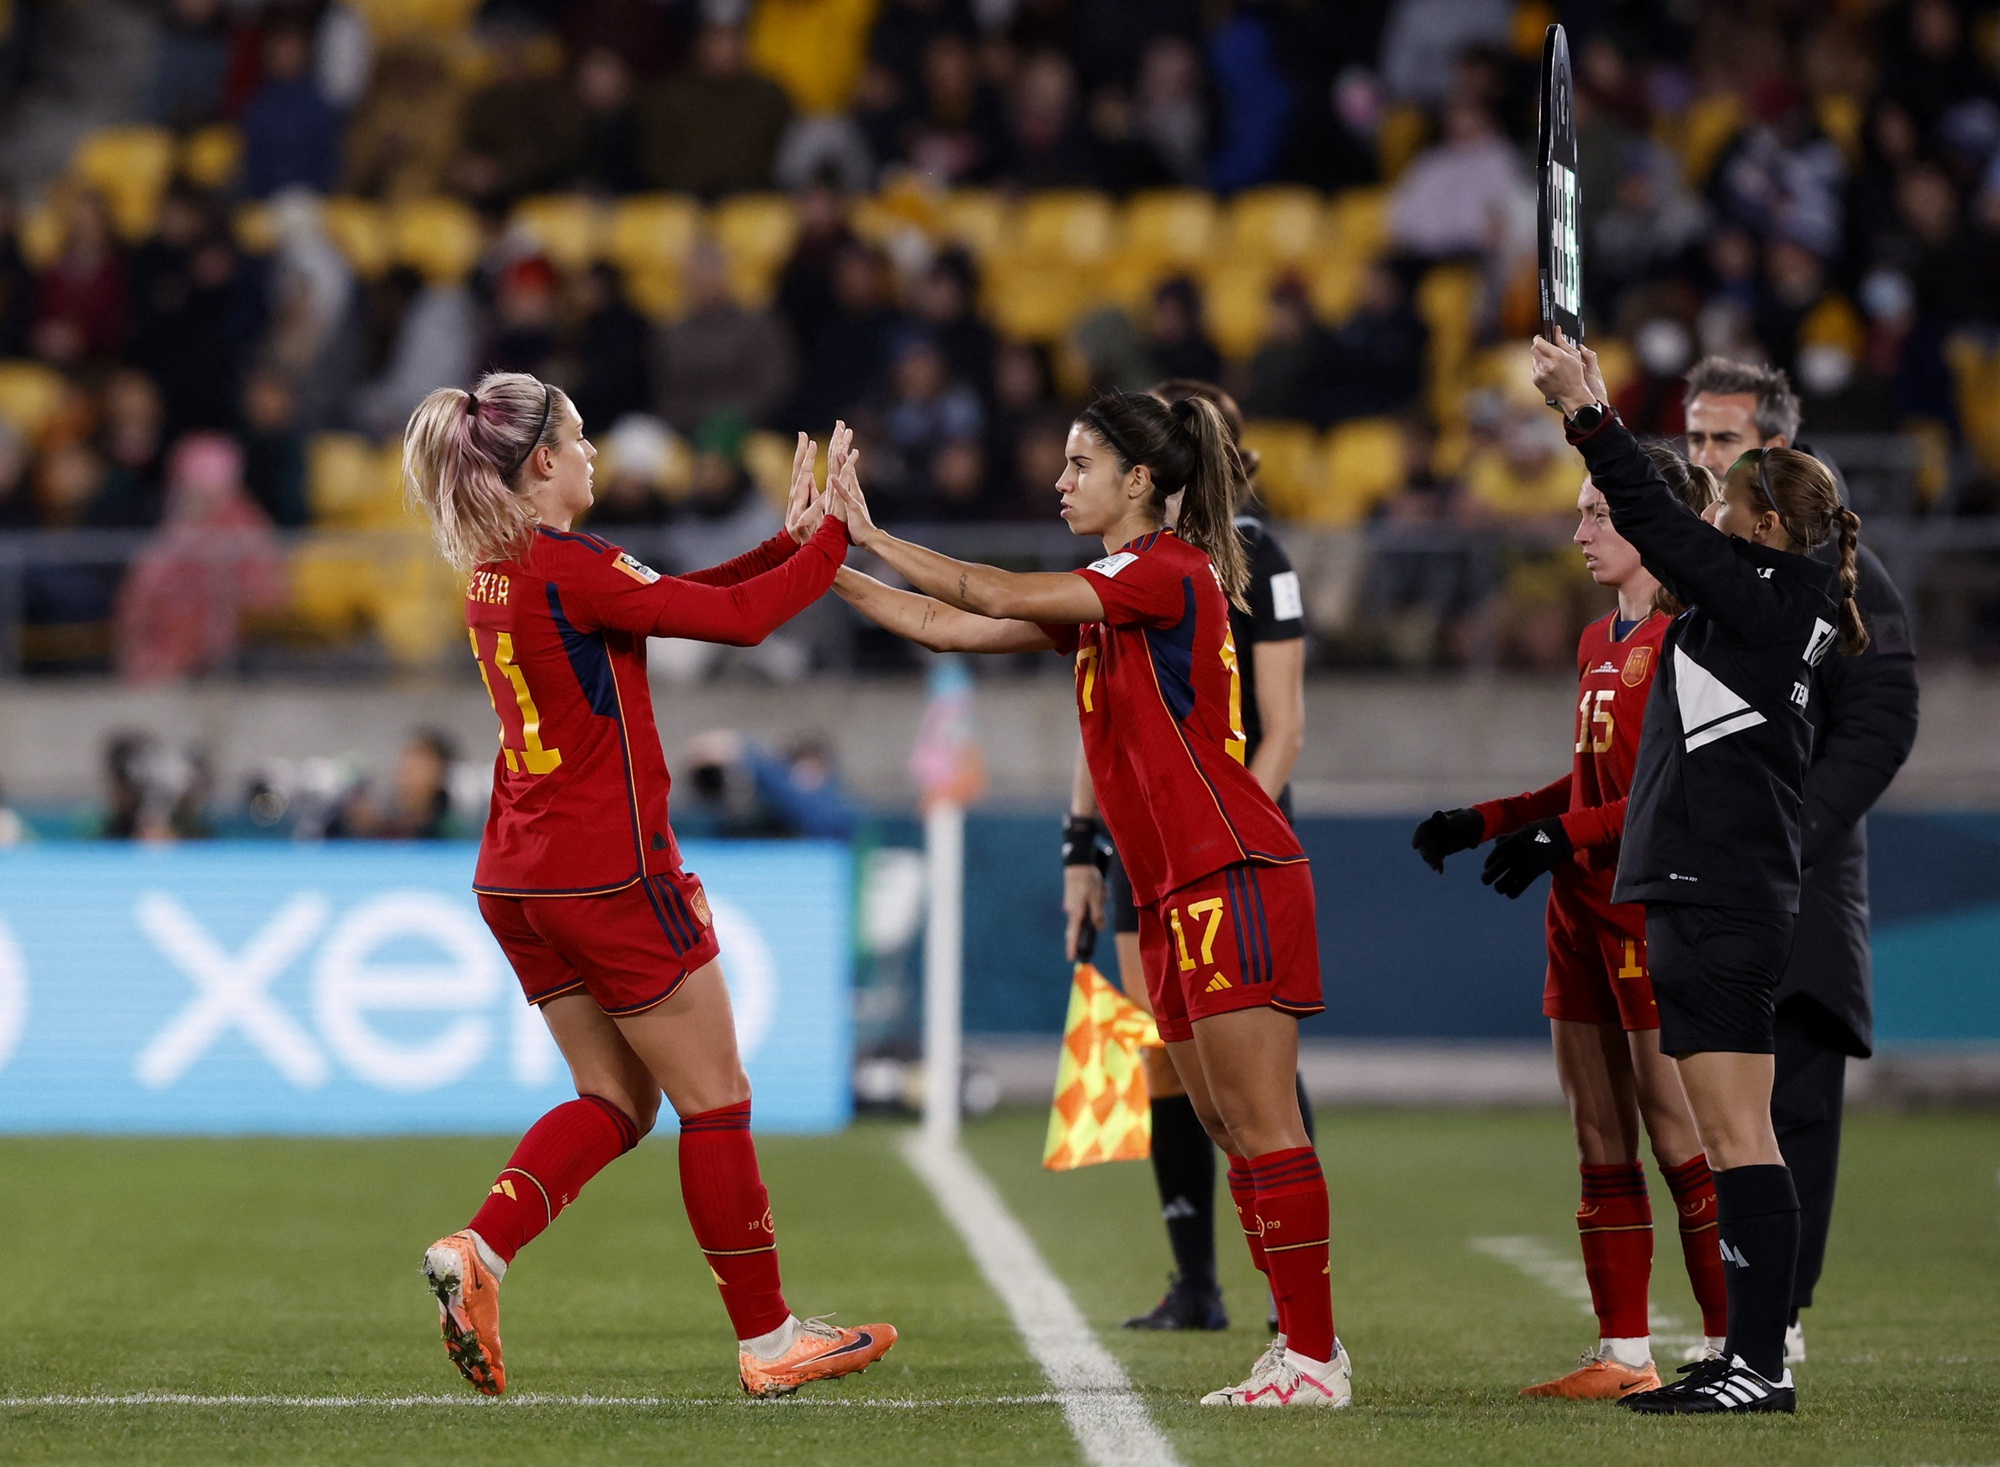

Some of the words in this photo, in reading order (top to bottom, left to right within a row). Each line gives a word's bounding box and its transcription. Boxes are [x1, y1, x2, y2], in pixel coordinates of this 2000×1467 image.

[466, 571, 509, 605] EXIA
[1575, 690, 1616, 753] 15
[1170, 897, 1224, 971] 17
